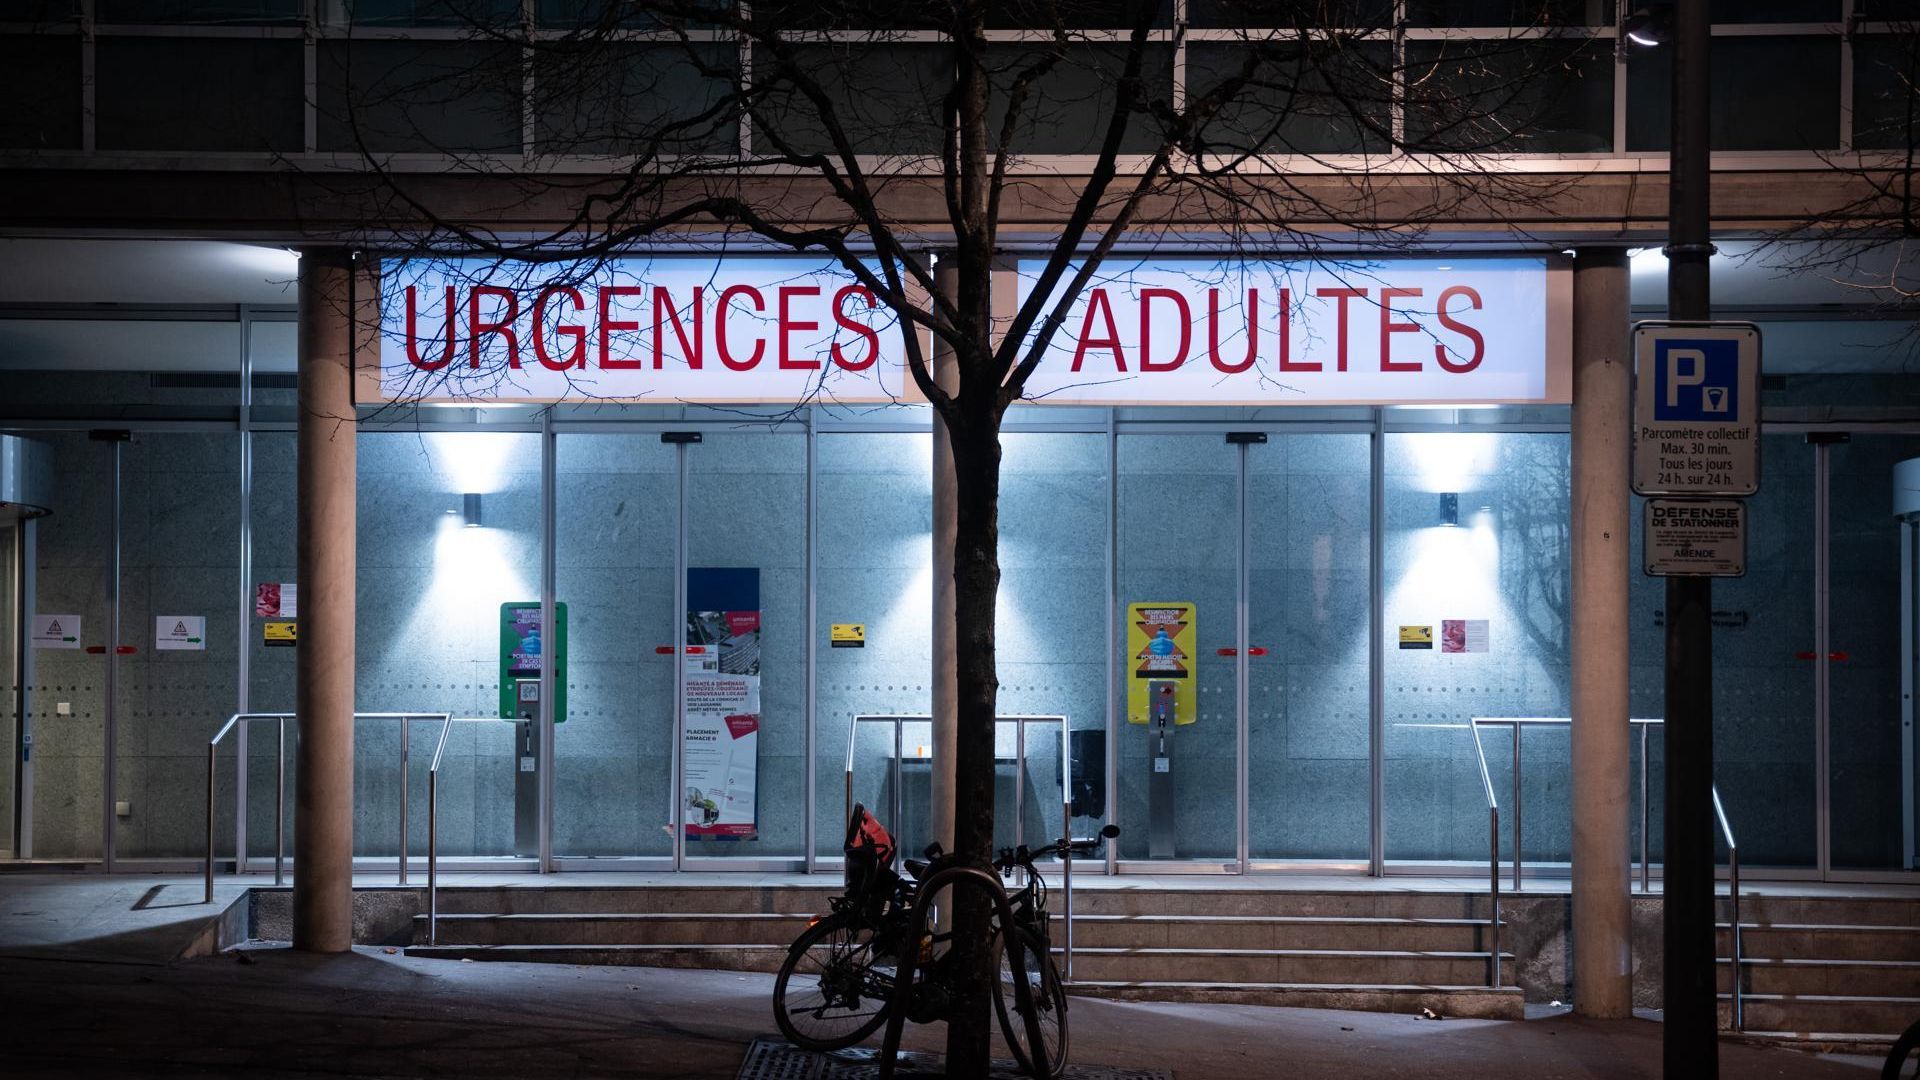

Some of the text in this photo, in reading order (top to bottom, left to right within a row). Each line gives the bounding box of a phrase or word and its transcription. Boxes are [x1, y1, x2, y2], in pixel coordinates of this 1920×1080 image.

[404, 284, 1485, 374] URGENCES ADULTES
[1667, 349, 1705, 406] P
[1642, 427, 1750, 440] Parcomètre collectif
[1661, 443, 1731, 455] Max. 30 min.
[1659, 457, 1733, 473] Tous les jours
[1658, 473, 1734, 485] 24 h. sur 24 h.
[1652, 518, 1739, 528] DE STATIONNER
[1674, 549, 1716, 558] AMENDE
